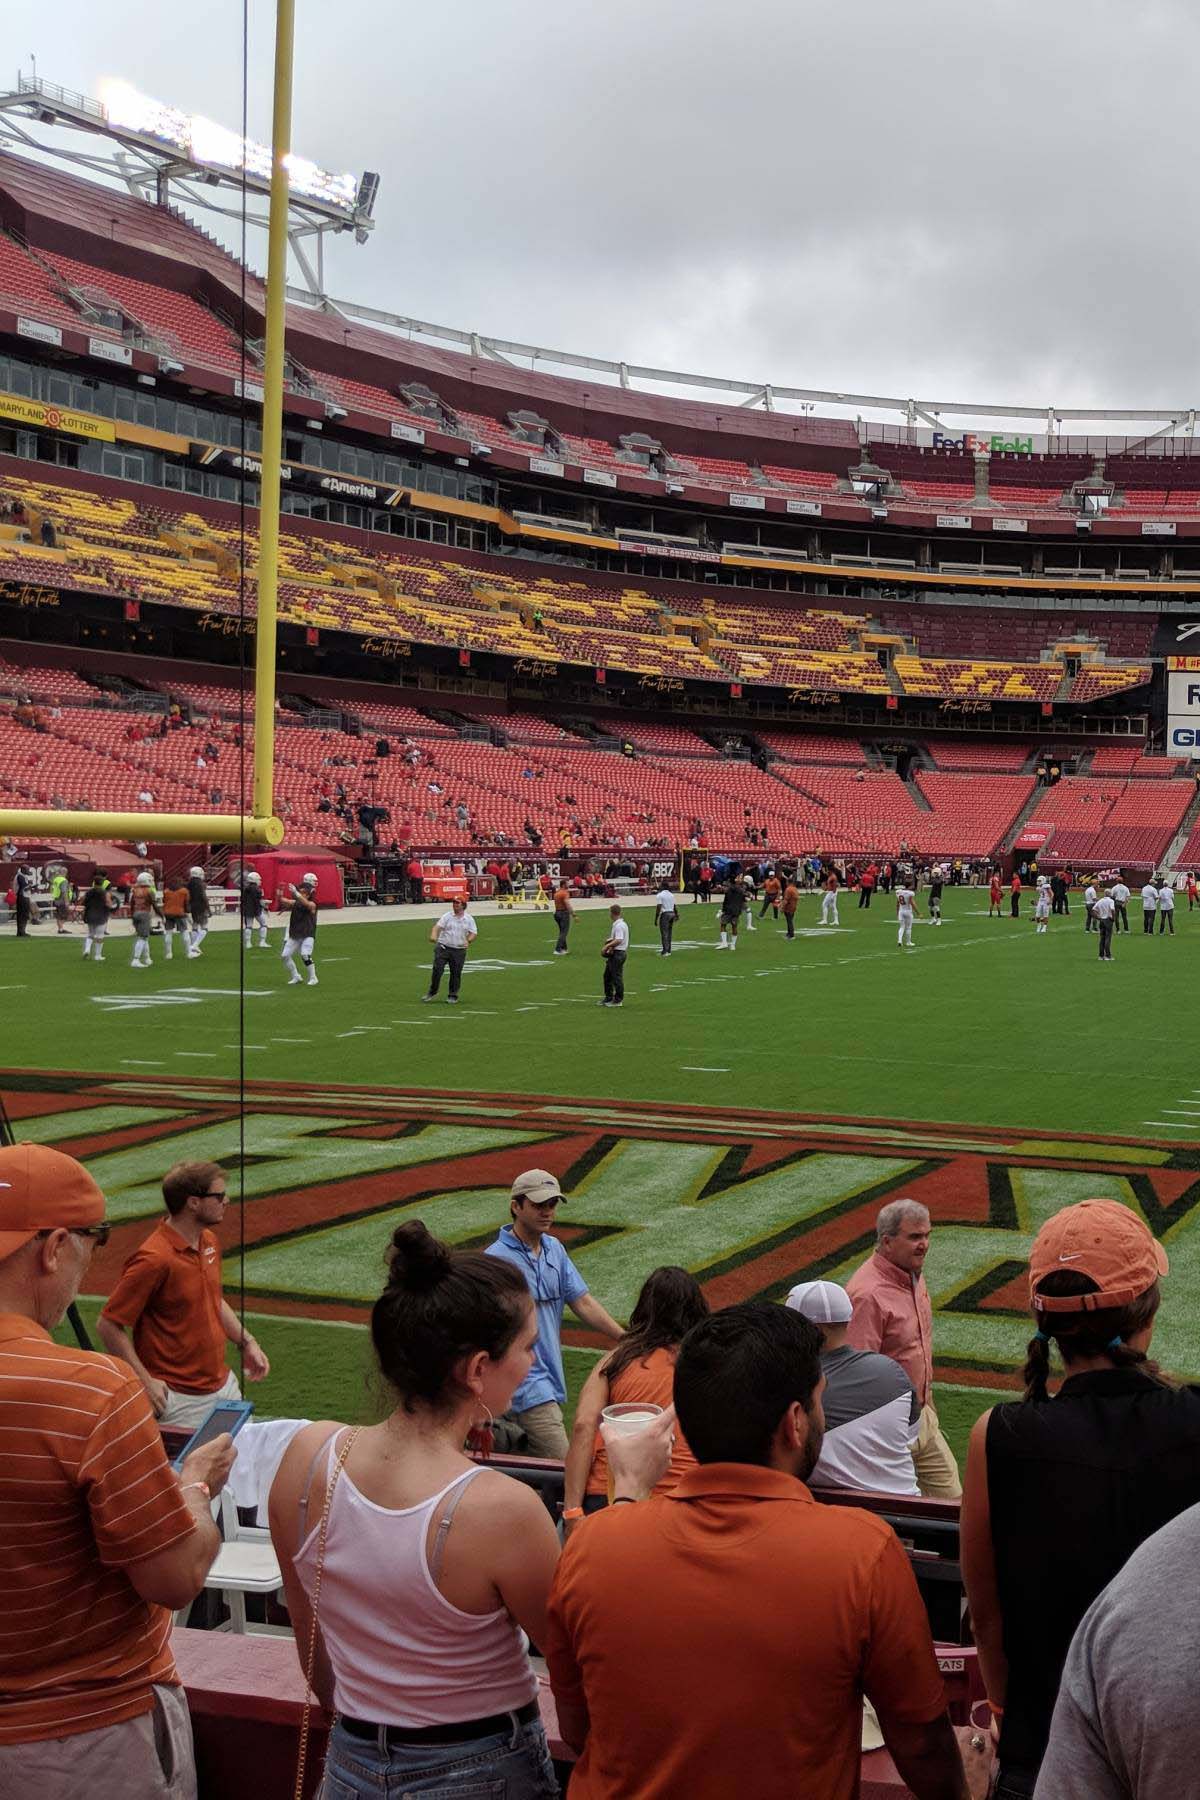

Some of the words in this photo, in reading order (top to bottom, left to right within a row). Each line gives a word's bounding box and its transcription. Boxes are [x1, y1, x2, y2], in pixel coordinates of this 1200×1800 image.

[63, 418, 99, 433] LOTTERY
[932, 431, 1033, 454] FedExField
[331, 479, 377, 499] Ameritel
